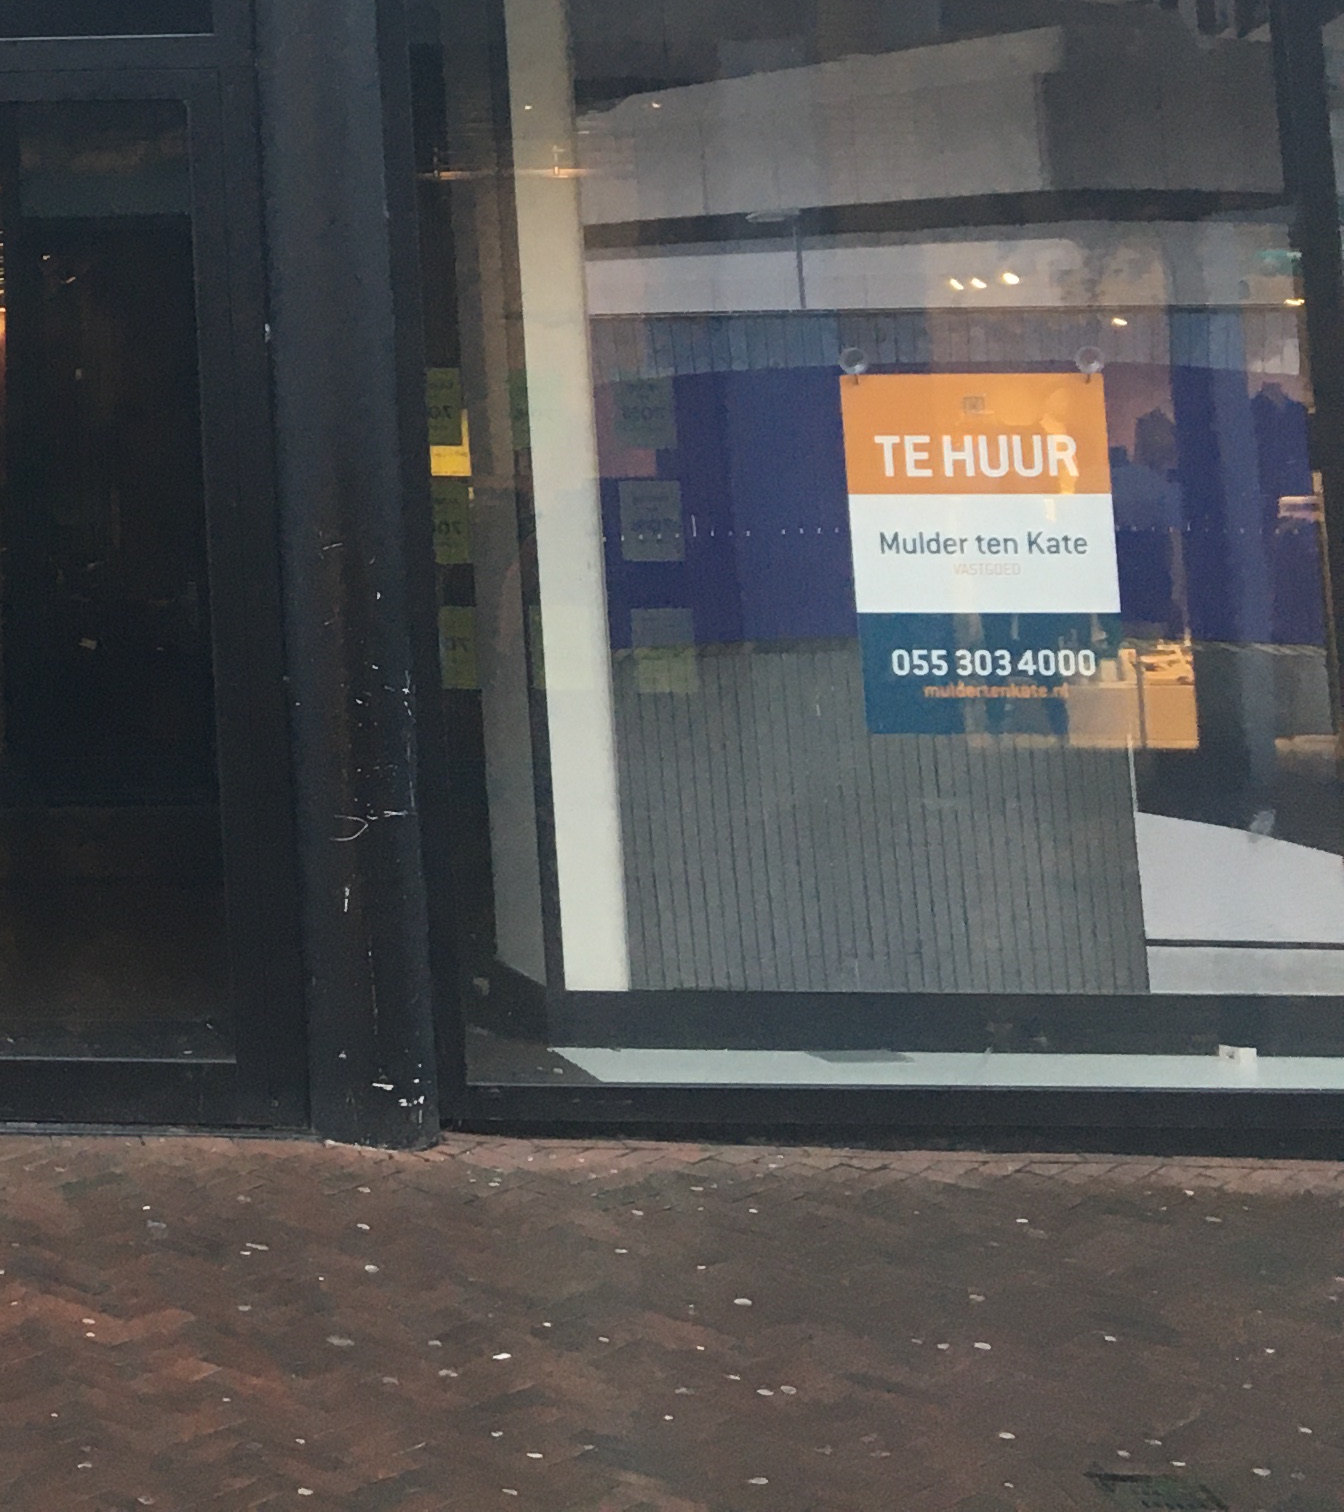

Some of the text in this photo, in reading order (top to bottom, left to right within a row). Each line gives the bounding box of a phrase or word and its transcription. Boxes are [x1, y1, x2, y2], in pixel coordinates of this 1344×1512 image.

[874, 434, 1080, 478] TE HUUR
[879, 531, 1088, 555] Mulder ten Kate
[953, 562, 1022, 577] VASTGOED
[891, 648, 1097, 676] 055 303 4000
